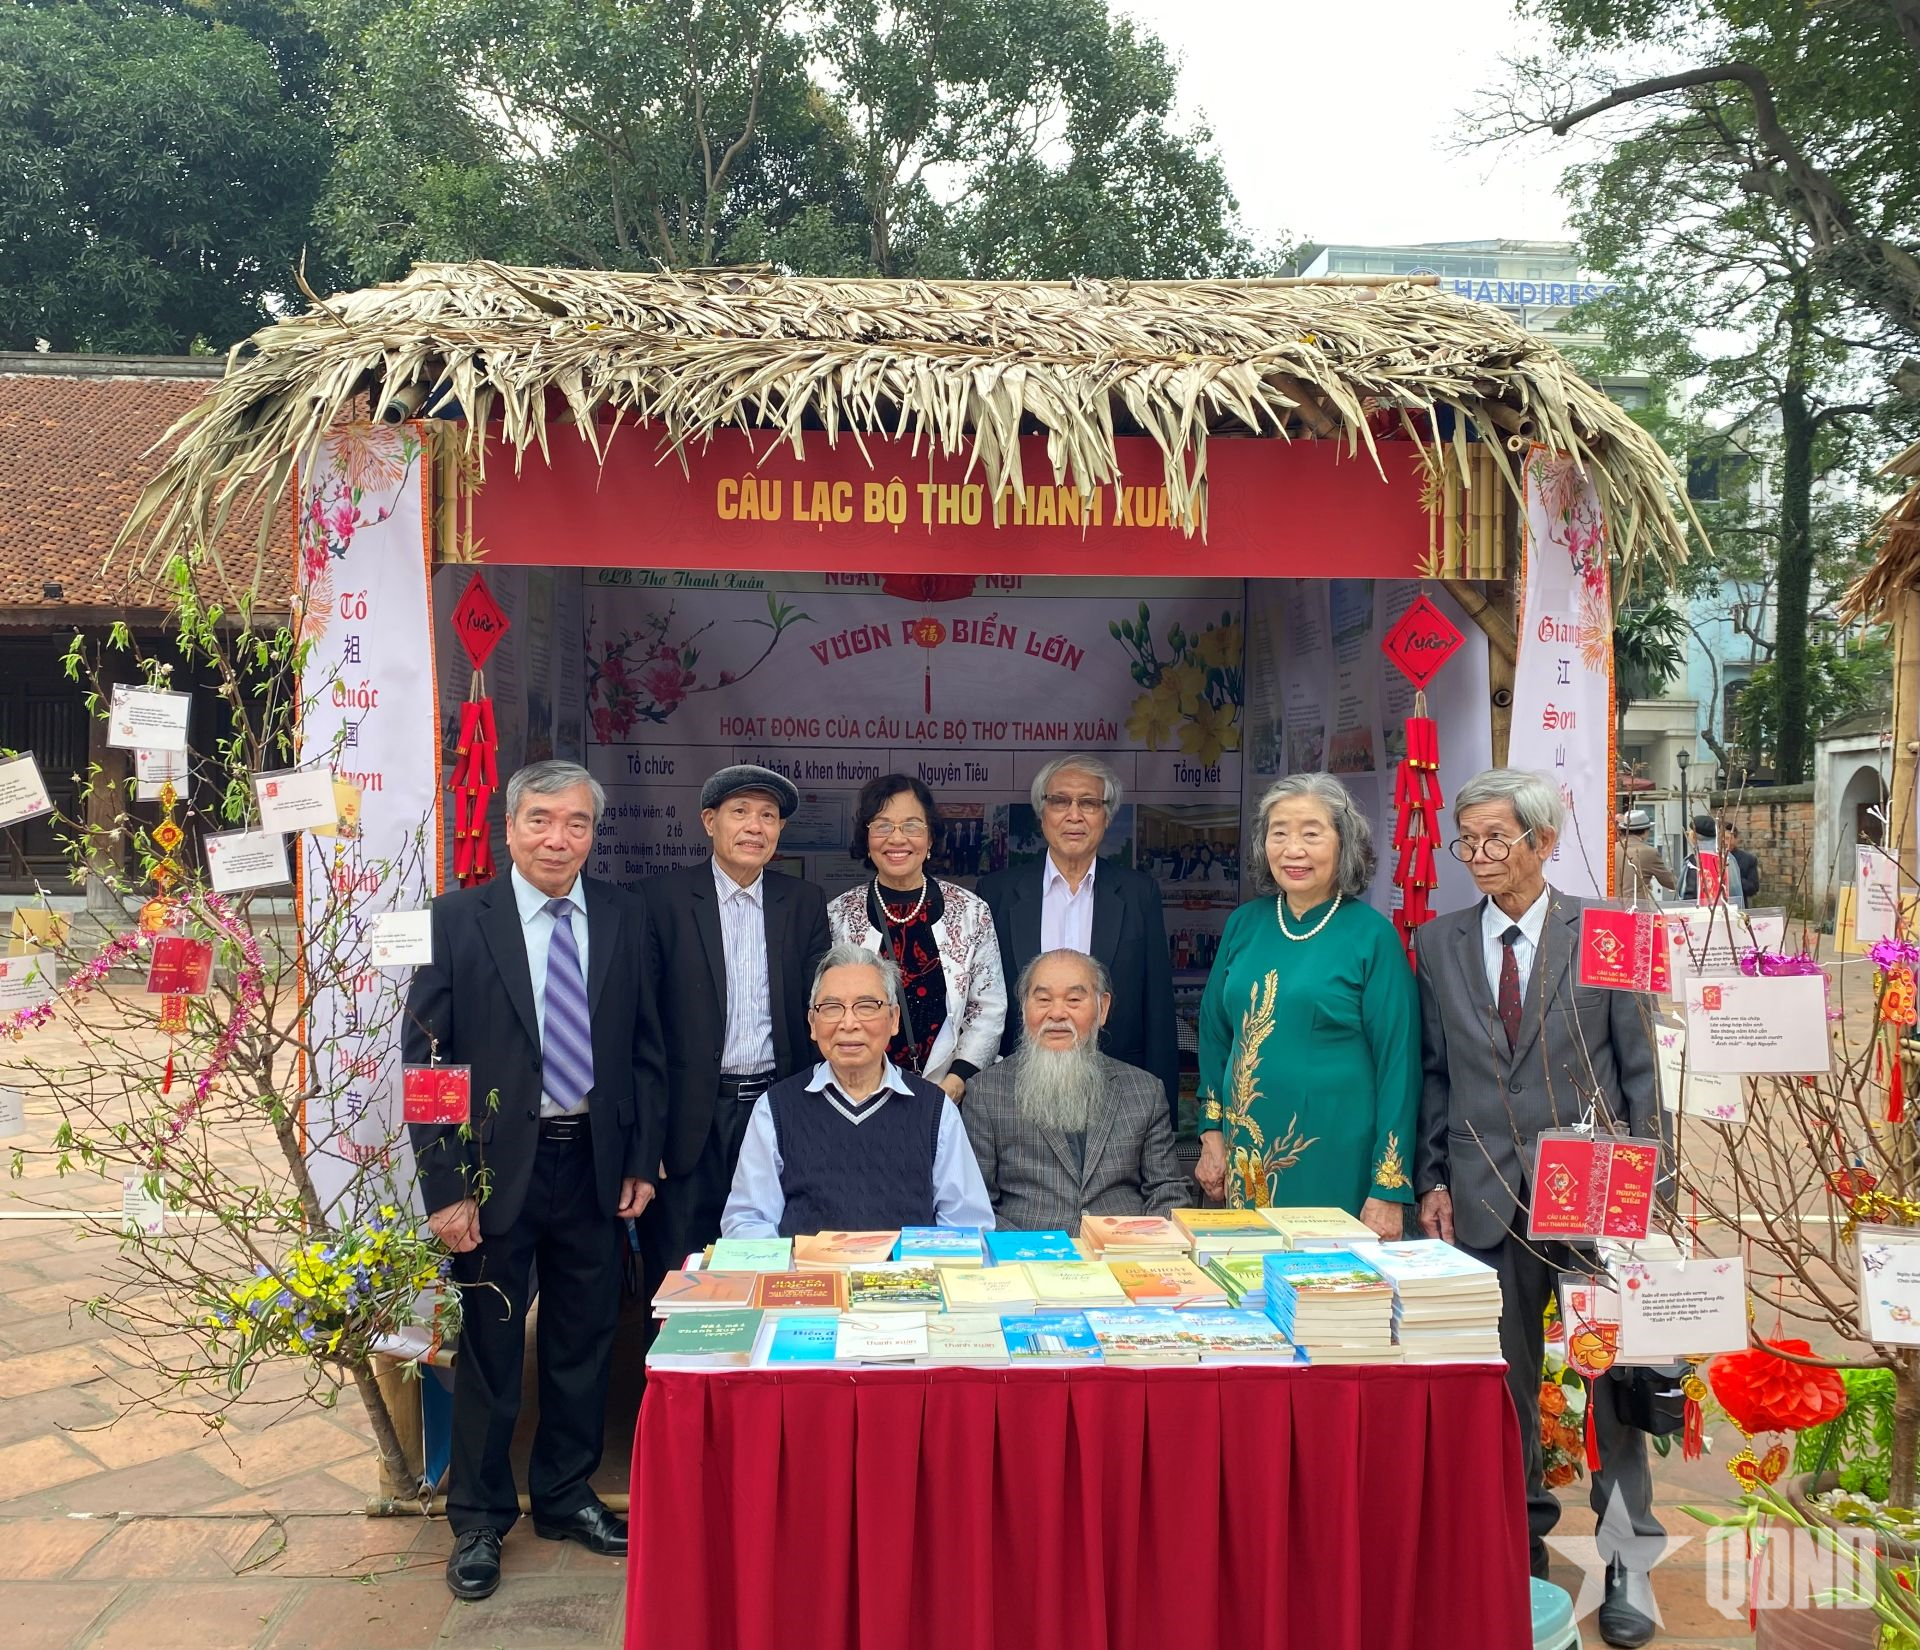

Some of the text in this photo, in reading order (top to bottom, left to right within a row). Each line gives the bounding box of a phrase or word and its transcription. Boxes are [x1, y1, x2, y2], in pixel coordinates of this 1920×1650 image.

[717, 472, 781, 521] CÂU
[793, 481, 852, 532] LẠC
[863, 476, 907, 533] BỘ
[916, 481, 984, 524] THƠ
[638, 570, 668, 586] Thơ
[672, 571, 719, 588] Thanh
[724, 573, 765, 589] Xuân
[340, 590, 367, 619] Tổ
[810, 624, 892, 666] VƯƠN
[952, 612, 1018, 650] BIỂN
[1024, 631, 1085, 672] LỚN
[920, 624, 938, 642] 福
[1538, 616, 1581, 649] Giang
[344, 634, 360, 664] 祖
[1557, 658, 1571, 686] 江
[332, 680, 379, 709] Quốc
[719, 713, 1118, 744] HOẠT ĐỘNG CỦA CÂU LẠC BỘ THƠ THANH XUÂN
[1542, 703, 1576, 731] Sơn
[627, 751, 675, 775] Tổ chức
[1555, 744, 1566, 768] 山
[794, 763, 803, 778] &
[806, 761, 833, 779] khen
[836, 760, 880, 780] thưởng
[918, 761, 988, 785] Nguyên Tiêu
[1173, 760, 1221, 786] Tổng kết
[619, 805, 628, 817] số
[630, 805, 640, 820] hội
[665, 806, 676, 818] 40
[667, 825, 672, 837] 2
[674, 821, 683, 837] tổ
[631, 843, 653, 857] nhiệm
[655, 844, 660, 855] 3
[663, 843, 687, 856] thành
[689, 843, 707, 856] viên
